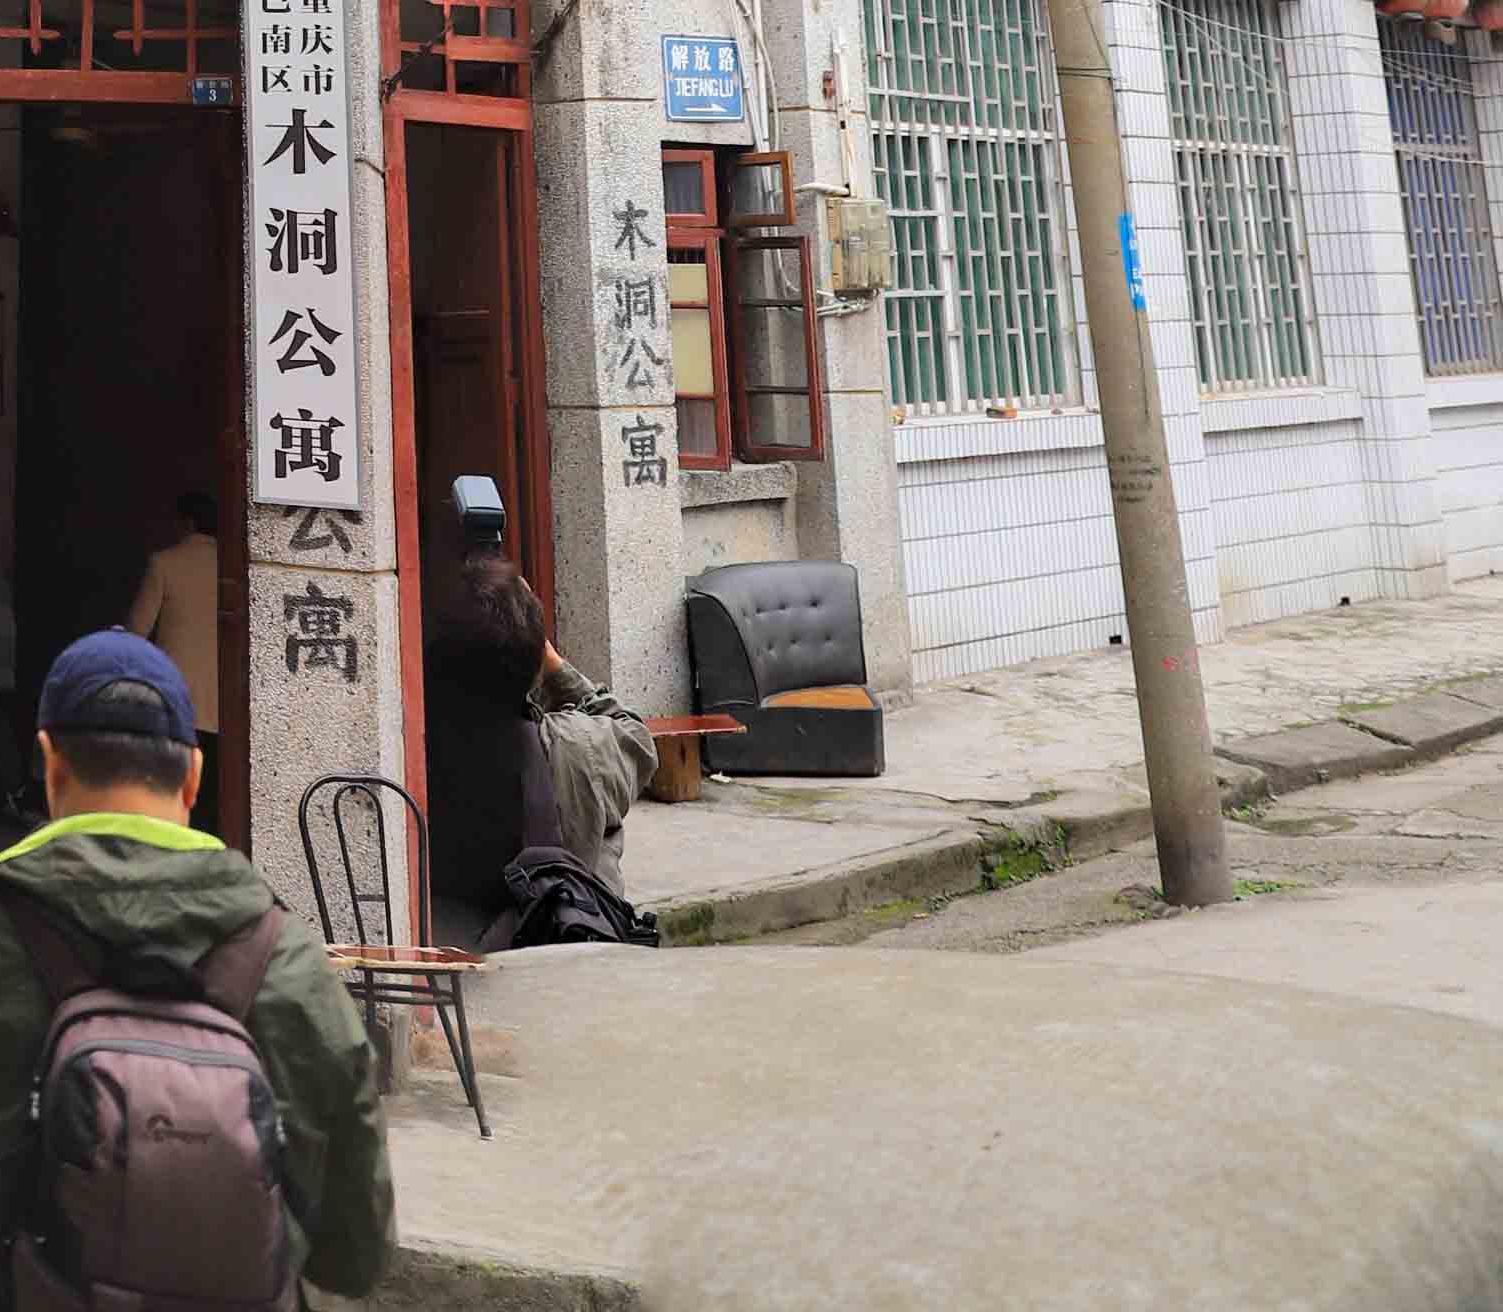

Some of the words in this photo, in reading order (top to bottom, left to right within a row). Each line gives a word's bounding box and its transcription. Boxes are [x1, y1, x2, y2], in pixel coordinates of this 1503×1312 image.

[671, 44, 735, 73] 解放路
[263, 108, 346, 482] 木洞公寓
[611, 199, 669, 488] 木洞公寓
